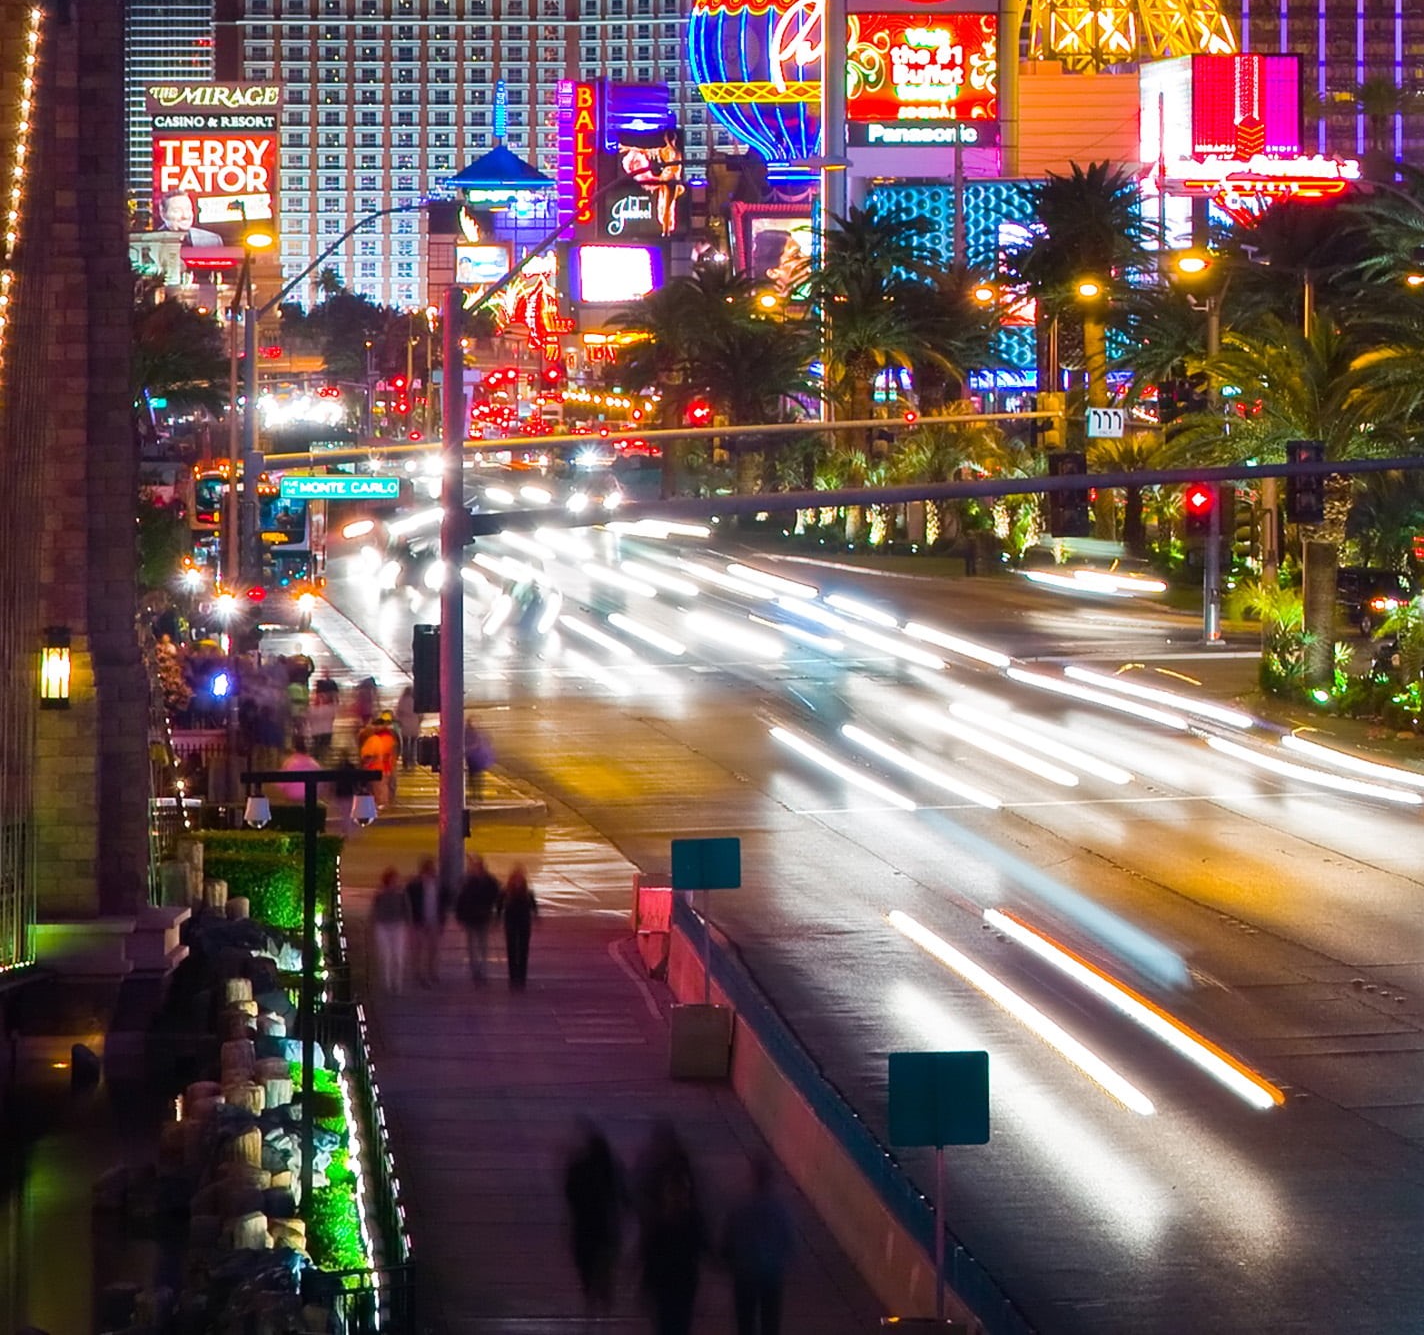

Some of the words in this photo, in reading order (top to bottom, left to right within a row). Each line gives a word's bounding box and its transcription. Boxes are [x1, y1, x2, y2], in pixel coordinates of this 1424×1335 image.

[150, 87, 178, 99] THE
[160, 86, 279, 107] MIRAGE
[154, 116, 205, 127] CASINO
[221, 117, 275, 127] RESORT
[868, 123, 978, 142] Panasonic
[159, 140, 270, 165] TERRY
[161, 166, 268, 192] FATOR
[300, 482, 346, 493] MONTE
[350, 482, 397, 493] CARLO
